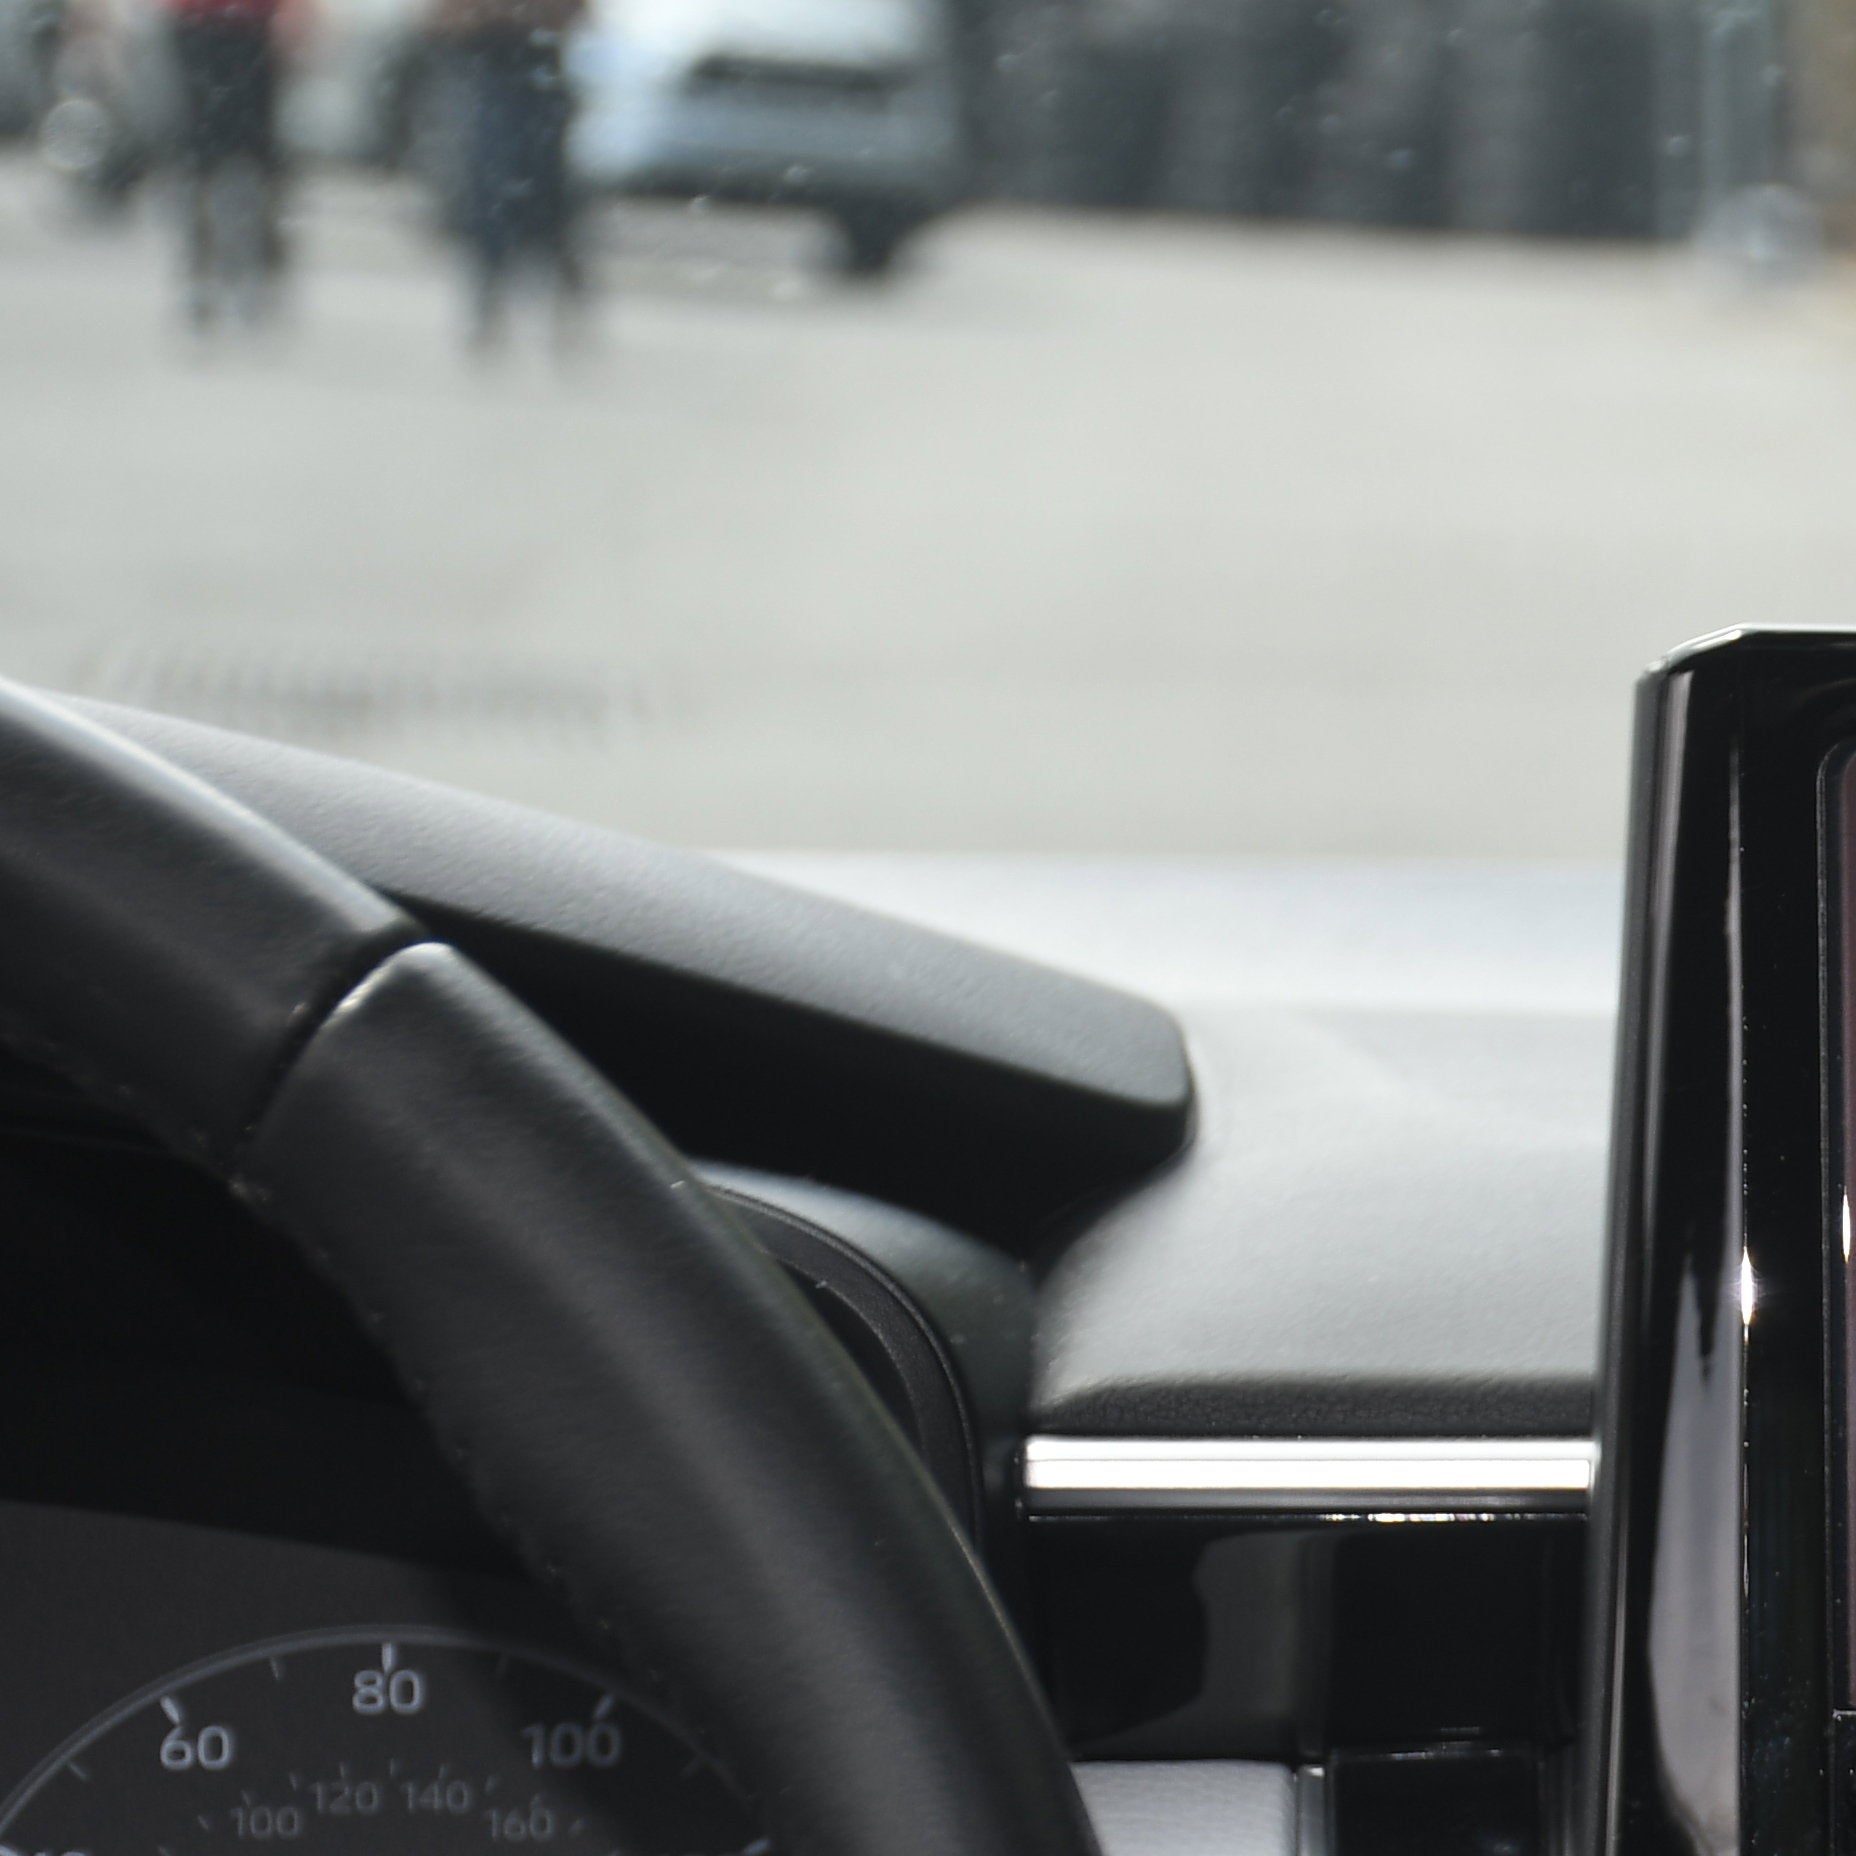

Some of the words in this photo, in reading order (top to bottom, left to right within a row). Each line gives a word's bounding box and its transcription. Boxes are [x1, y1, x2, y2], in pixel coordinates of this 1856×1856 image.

[353, 1671, 425, 1715] 80
[160, 1727, 233, 1770] 60
[523, 1723, 620, 1768] 100
[311, 1782, 379, 1814] 120
[405, 1782, 469, 1814] 140
[231, 1806, 299, 1838] 100
[489, 1808, 554, 1841] 160
